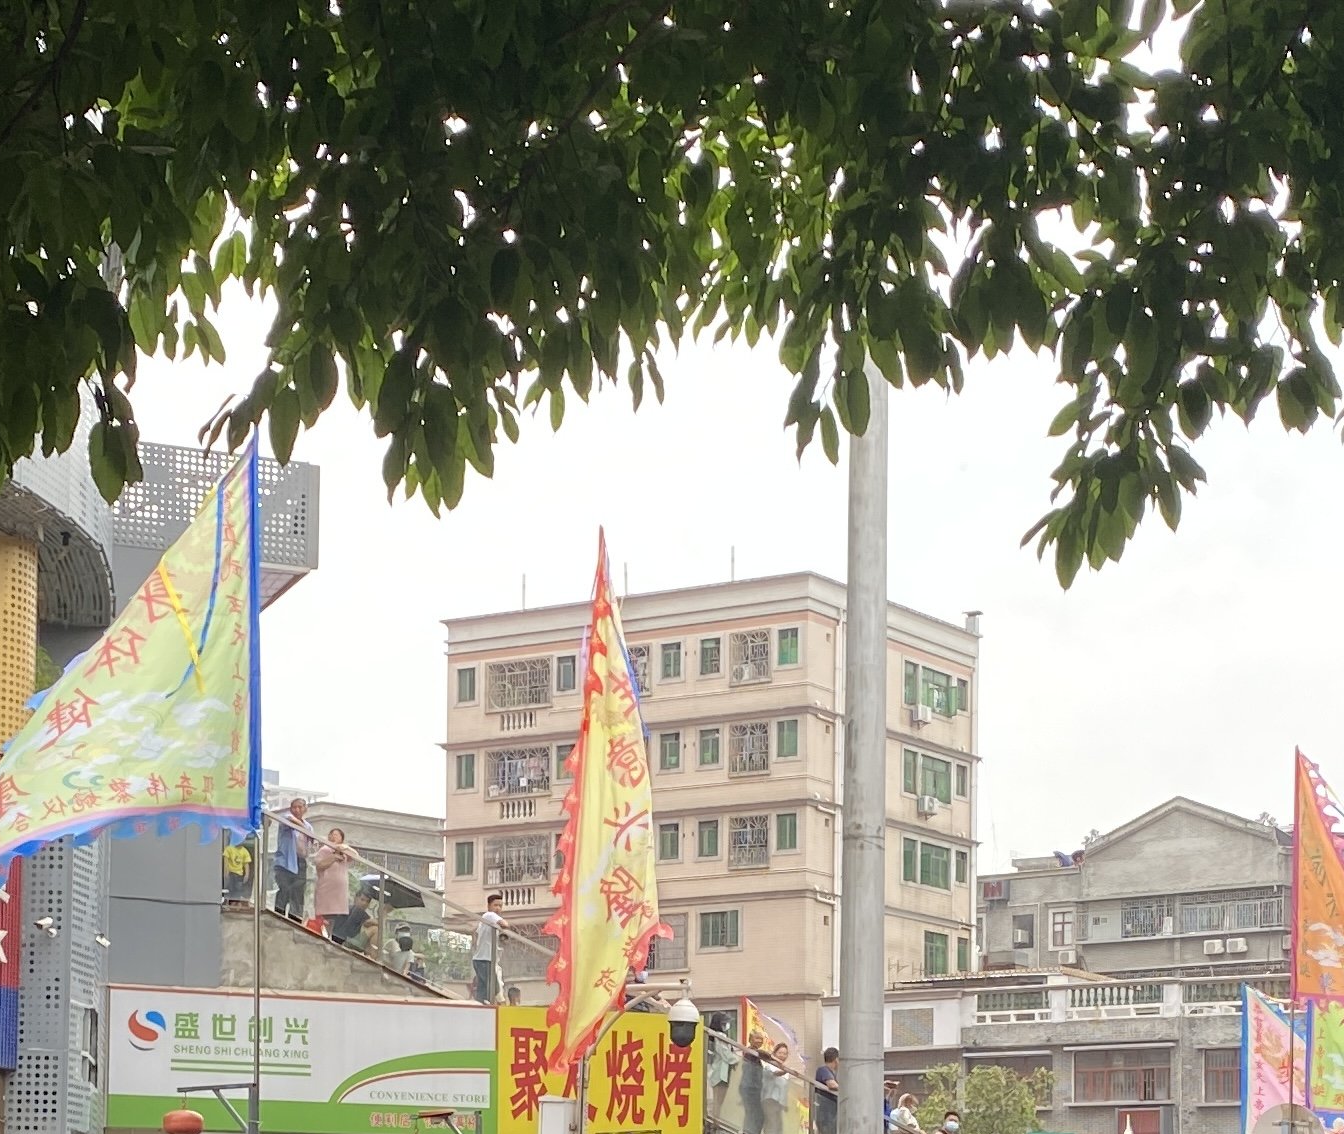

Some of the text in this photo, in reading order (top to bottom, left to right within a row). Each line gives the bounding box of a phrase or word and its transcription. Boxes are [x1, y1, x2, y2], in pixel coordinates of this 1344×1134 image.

[174, 1012, 309, 1046] 盛世创兴
[174, 1044, 211, 1056] SHENG
[214, 1046, 232, 1056] SHI
[509, 1026, 693, 1128] 聚烧烤
[452, 1093, 488, 1104] STORE
